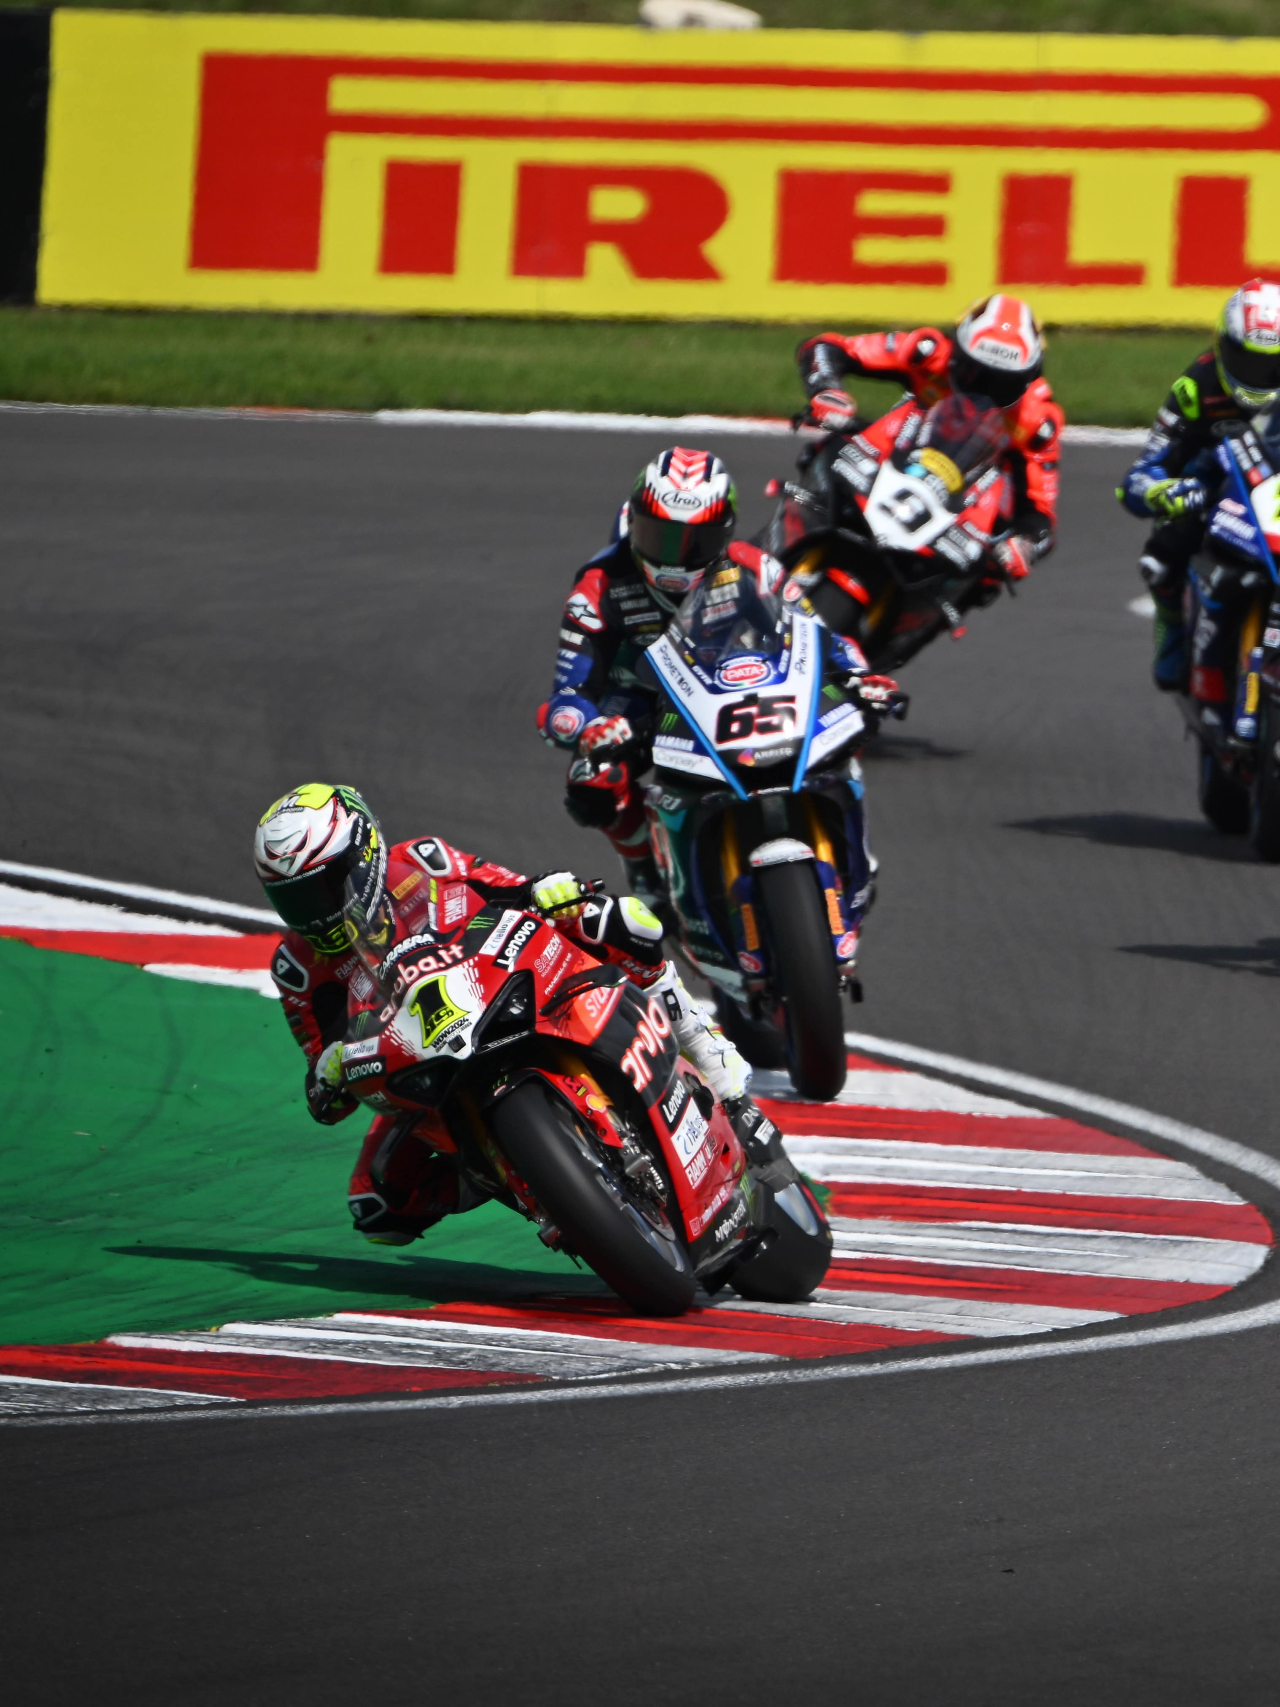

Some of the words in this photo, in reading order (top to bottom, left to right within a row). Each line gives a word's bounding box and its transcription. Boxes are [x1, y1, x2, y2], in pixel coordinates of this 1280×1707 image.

[668, 492, 697, 505] Arai
[726, 665, 757, 680] PATA
[715, 693, 797, 745] 65
[496, 920, 536, 969] Lenovo
[430, 1017, 471, 1049] WDW2024
[344, 1060, 383, 1081] Lenovo
[662, 1080, 686, 1124] Lenovo
